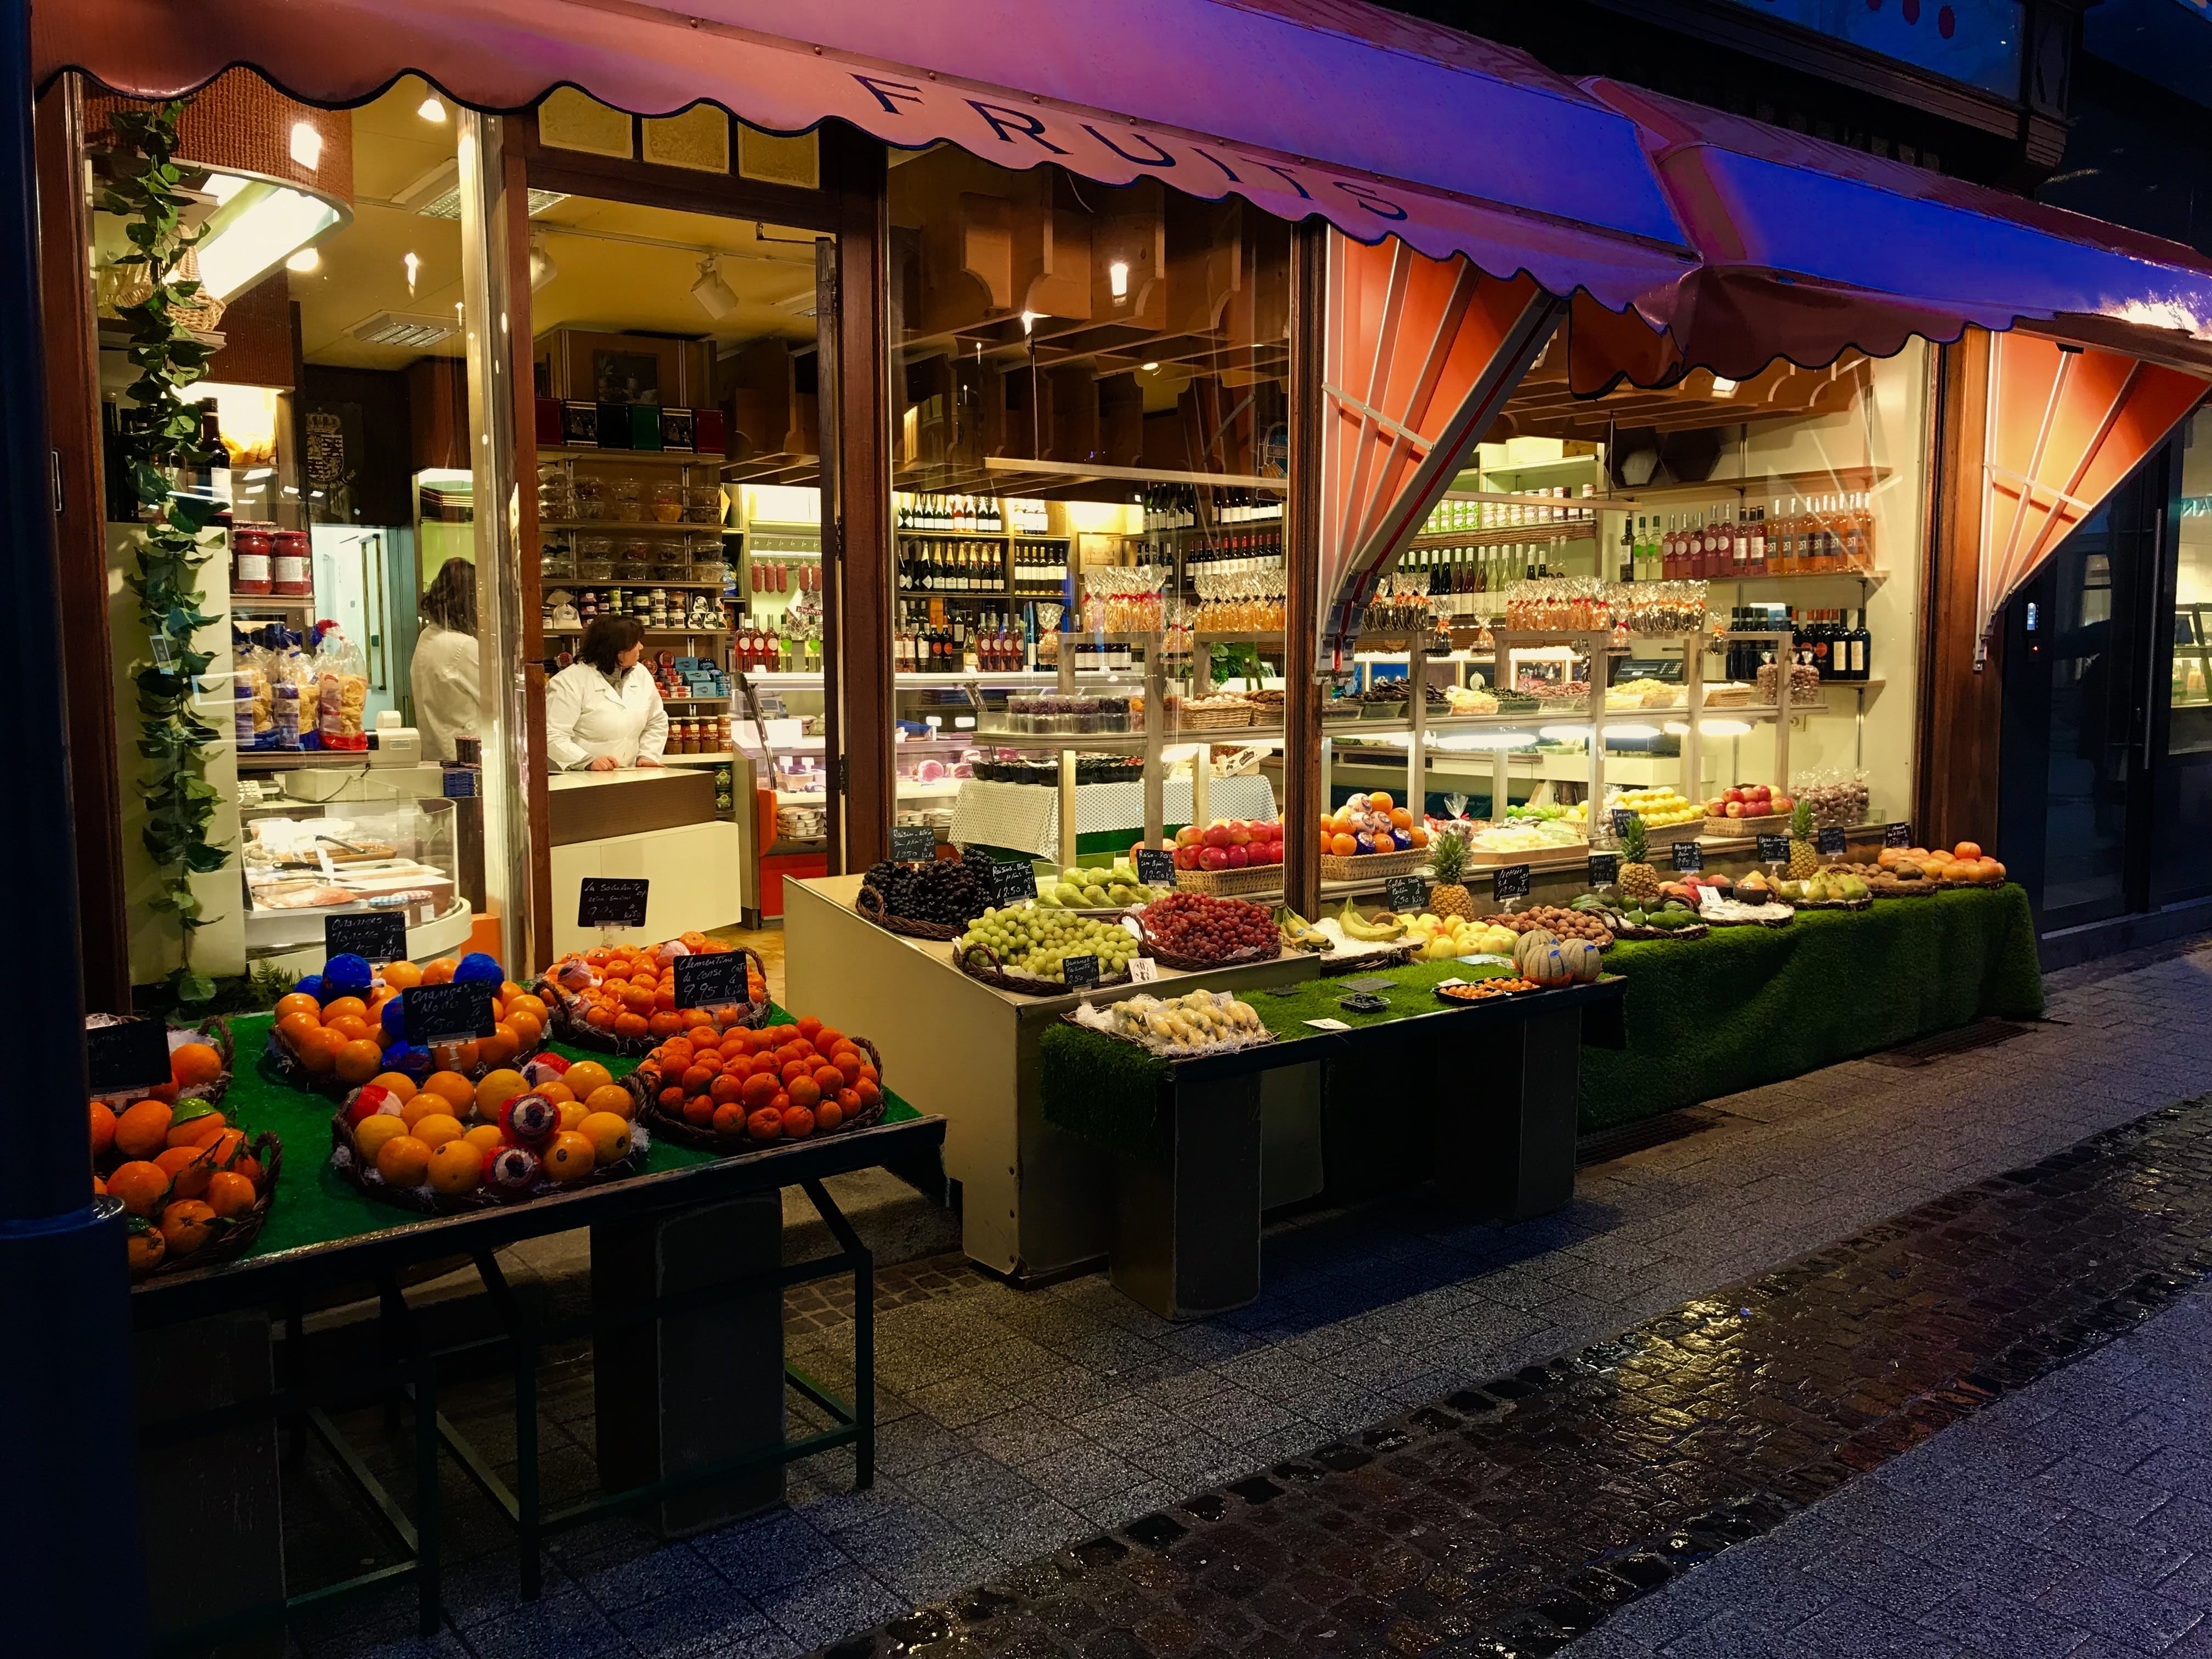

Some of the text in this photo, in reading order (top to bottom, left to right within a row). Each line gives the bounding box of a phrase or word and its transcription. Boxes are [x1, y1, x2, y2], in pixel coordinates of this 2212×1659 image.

[848, 72, 1408, 221] FRUITS
[997, 886, 1020, 899] 12.50
[412, 984, 470, 1003] Oranges
[684, 983, 718, 1003] 9.95
